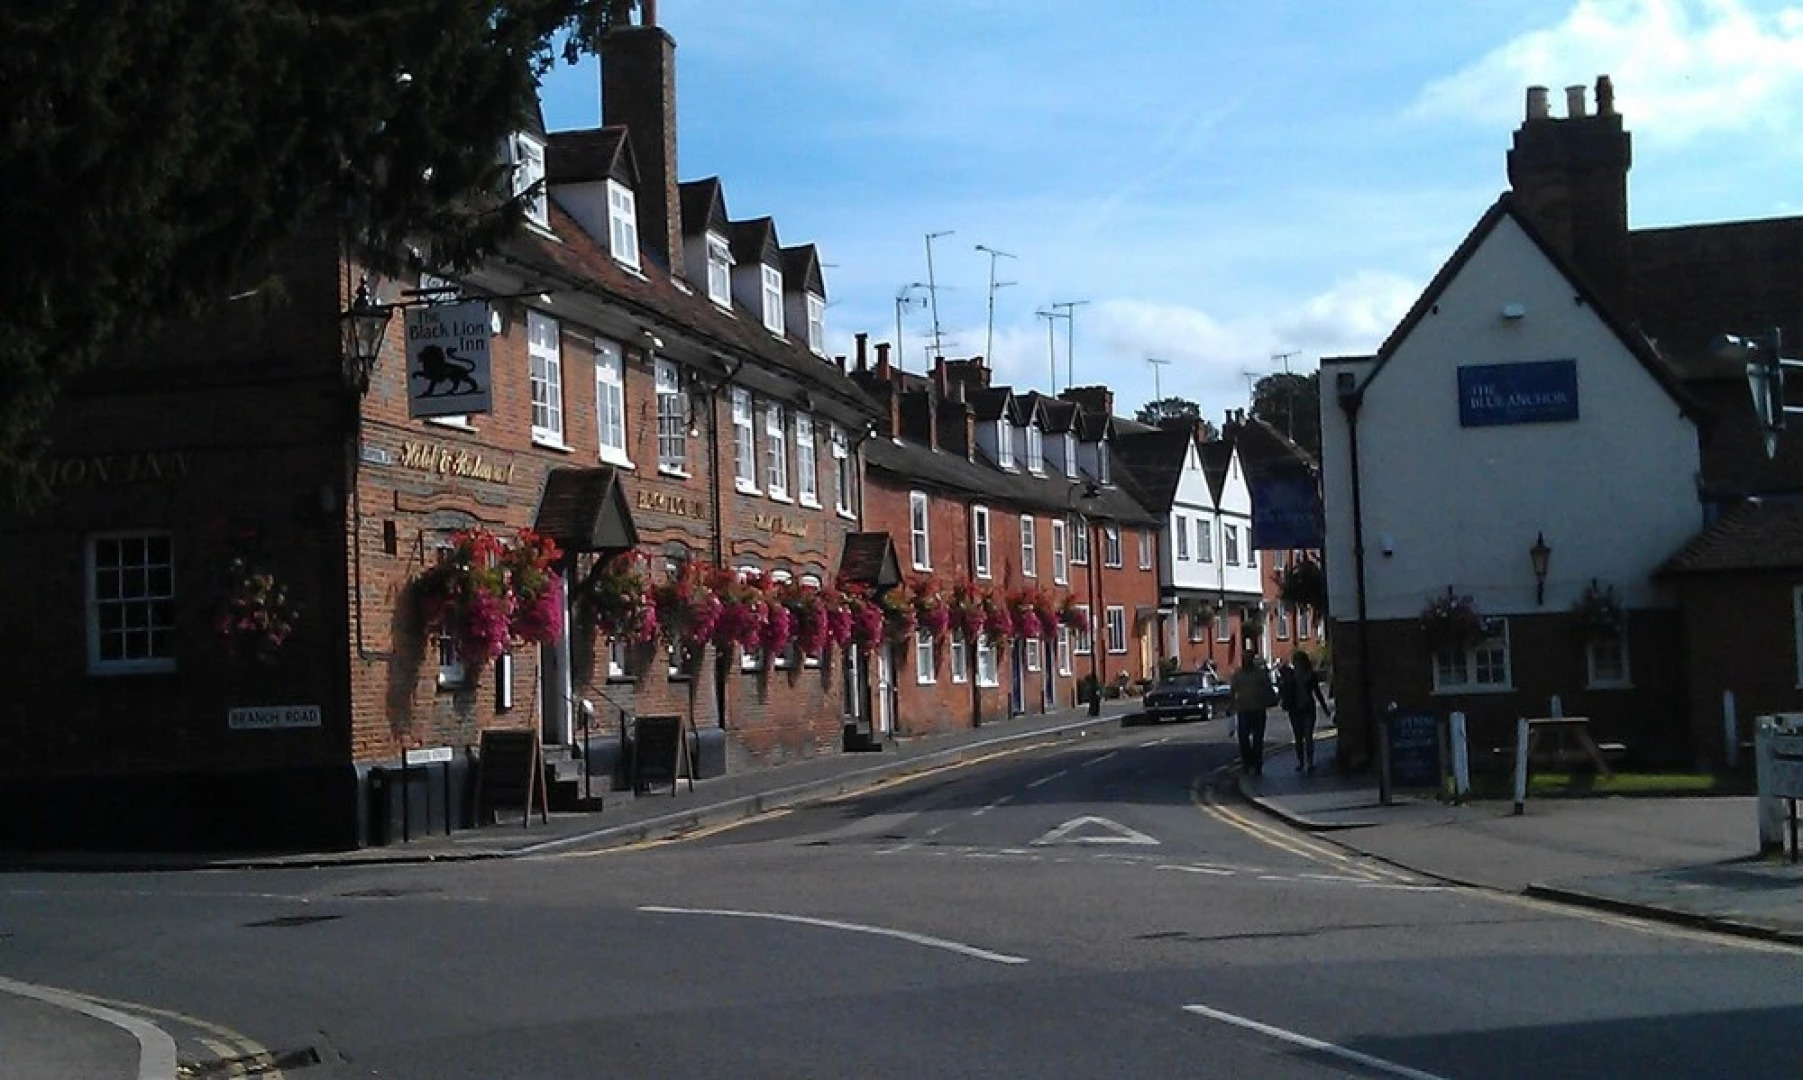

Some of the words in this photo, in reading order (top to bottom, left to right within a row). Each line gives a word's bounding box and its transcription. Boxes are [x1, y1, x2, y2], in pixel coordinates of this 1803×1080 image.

[416, 311, 440, 324] The
[409, 320, 449, 341] Black
[453, 320, 484, 336] Lion
[459, 336, 485, 352] Inn
[1469, 394, 1505, 409] BLUE
[1507, 388, 1567, 406] ANCHOR
[232, 711, 280, 724] BRANCH
[285, 709, 318, 723] ROAD
